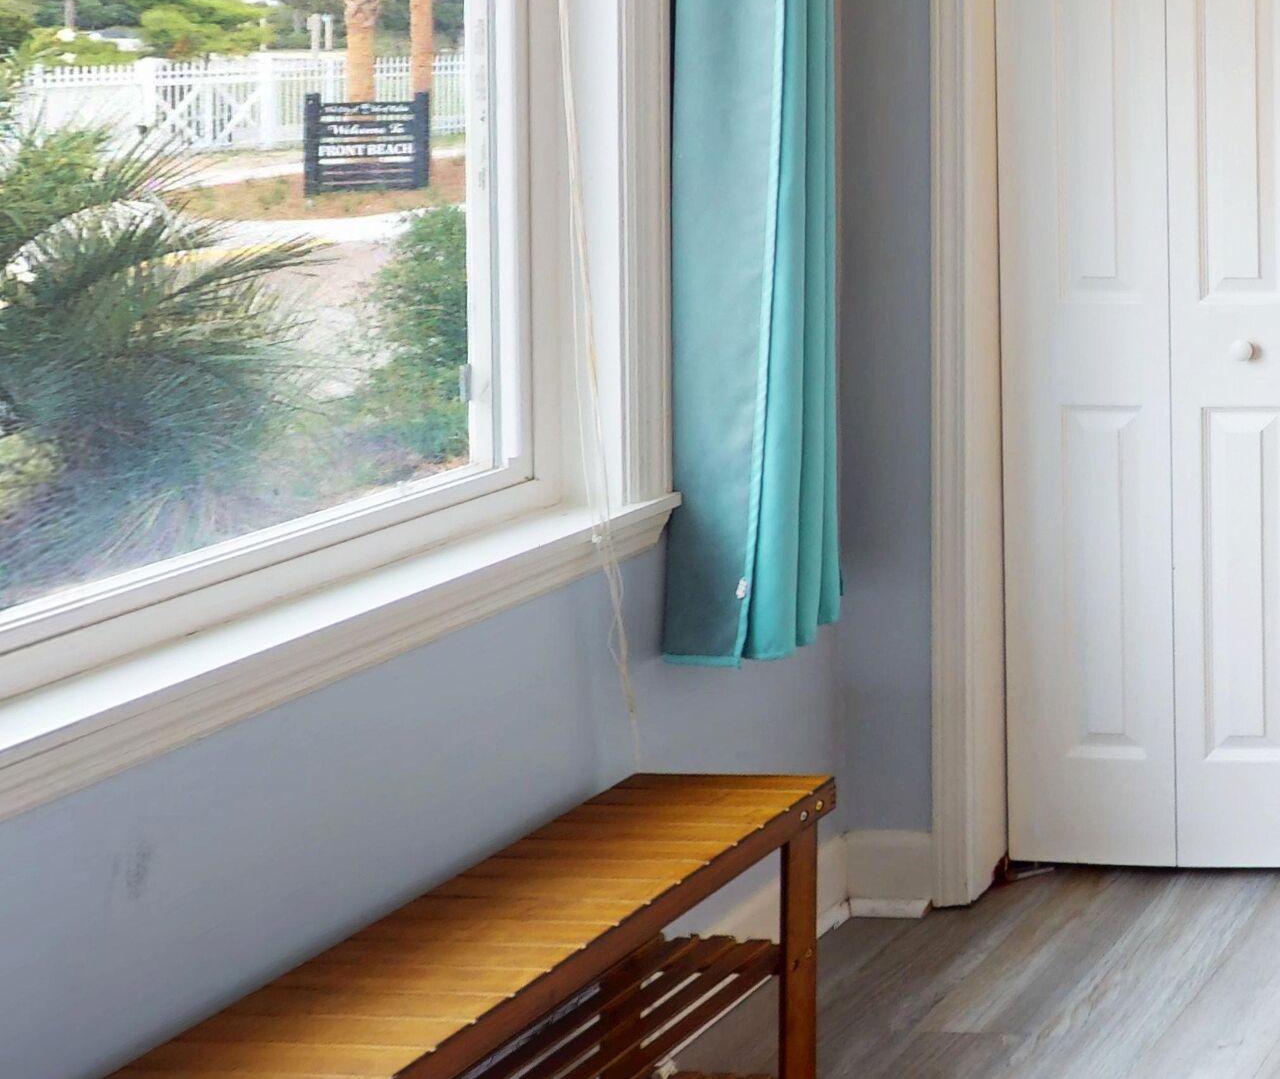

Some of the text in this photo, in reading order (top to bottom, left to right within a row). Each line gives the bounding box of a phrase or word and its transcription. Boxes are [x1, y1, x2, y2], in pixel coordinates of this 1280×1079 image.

[327, 124, 387, 135] Welcome
[318, 142, 413, 157] FRONT BEACH
